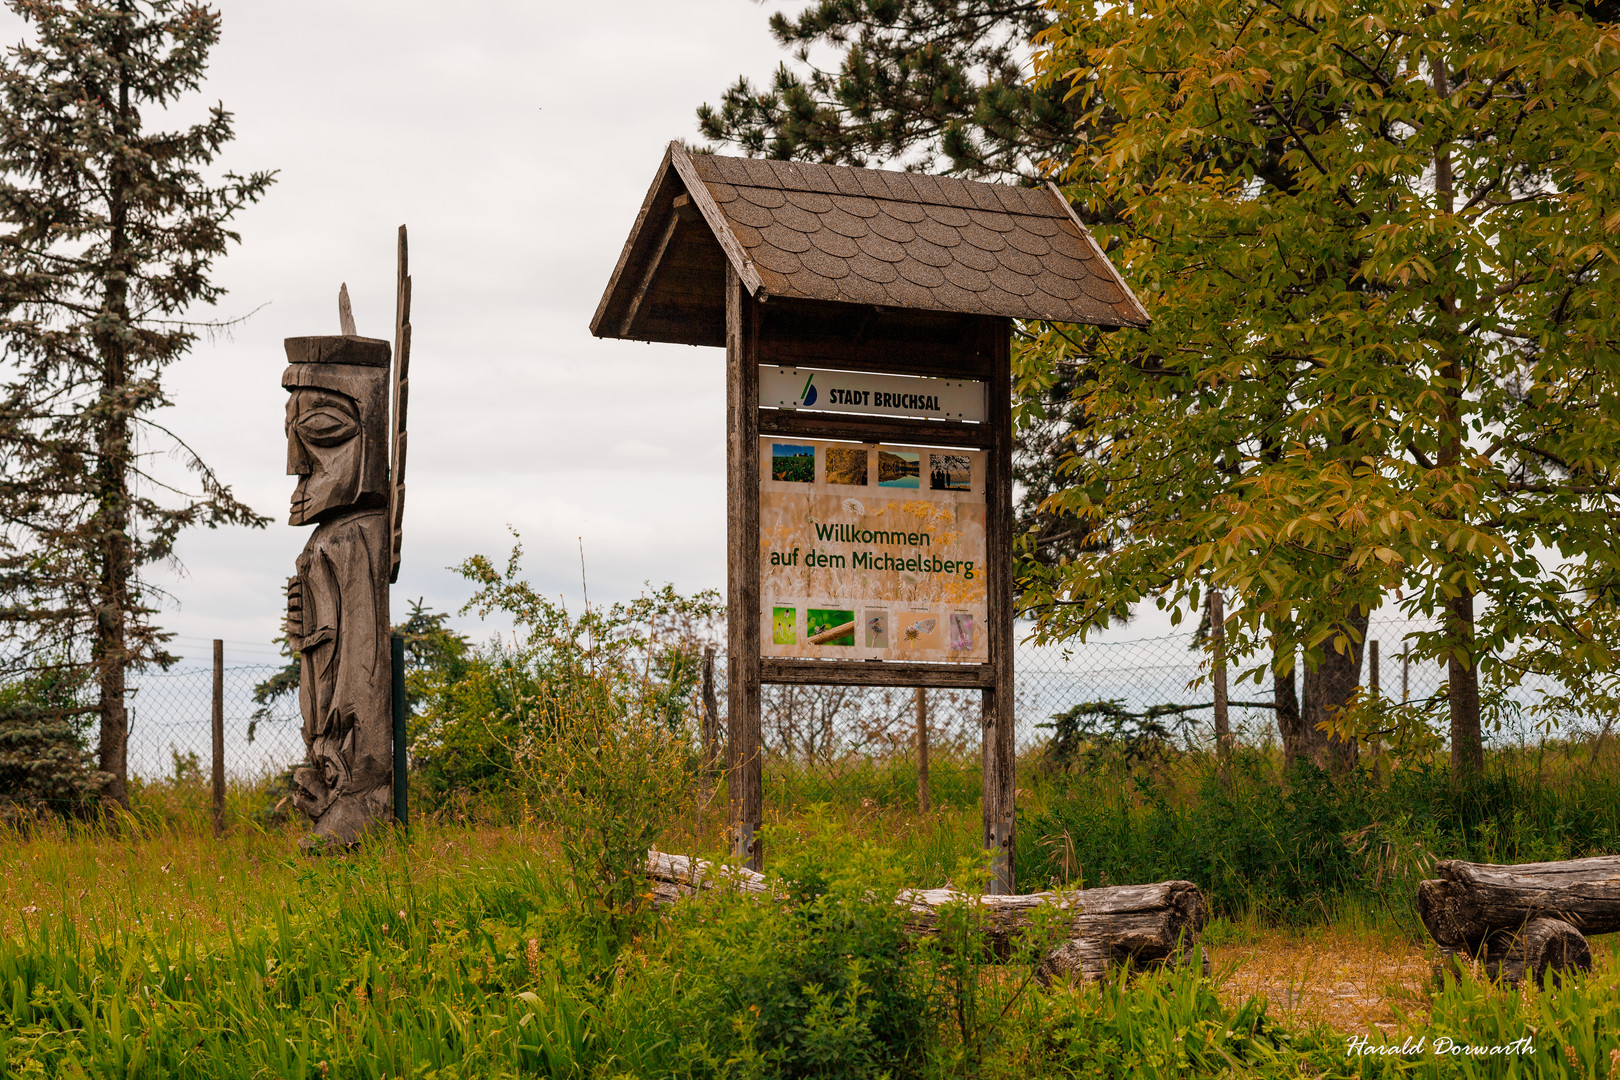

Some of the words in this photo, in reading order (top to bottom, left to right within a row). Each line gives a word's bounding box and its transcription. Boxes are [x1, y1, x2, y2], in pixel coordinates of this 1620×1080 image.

[829, 388, 870, 406] STADT
[874, 391, 941, 411] BRUCHSAL
[815, 523, 930, 546] Willkommen
[770, 548, 800, 566] auf
[804, 549, 846, 569] dem
[852, 551, 975, 580] Michaelsberg
